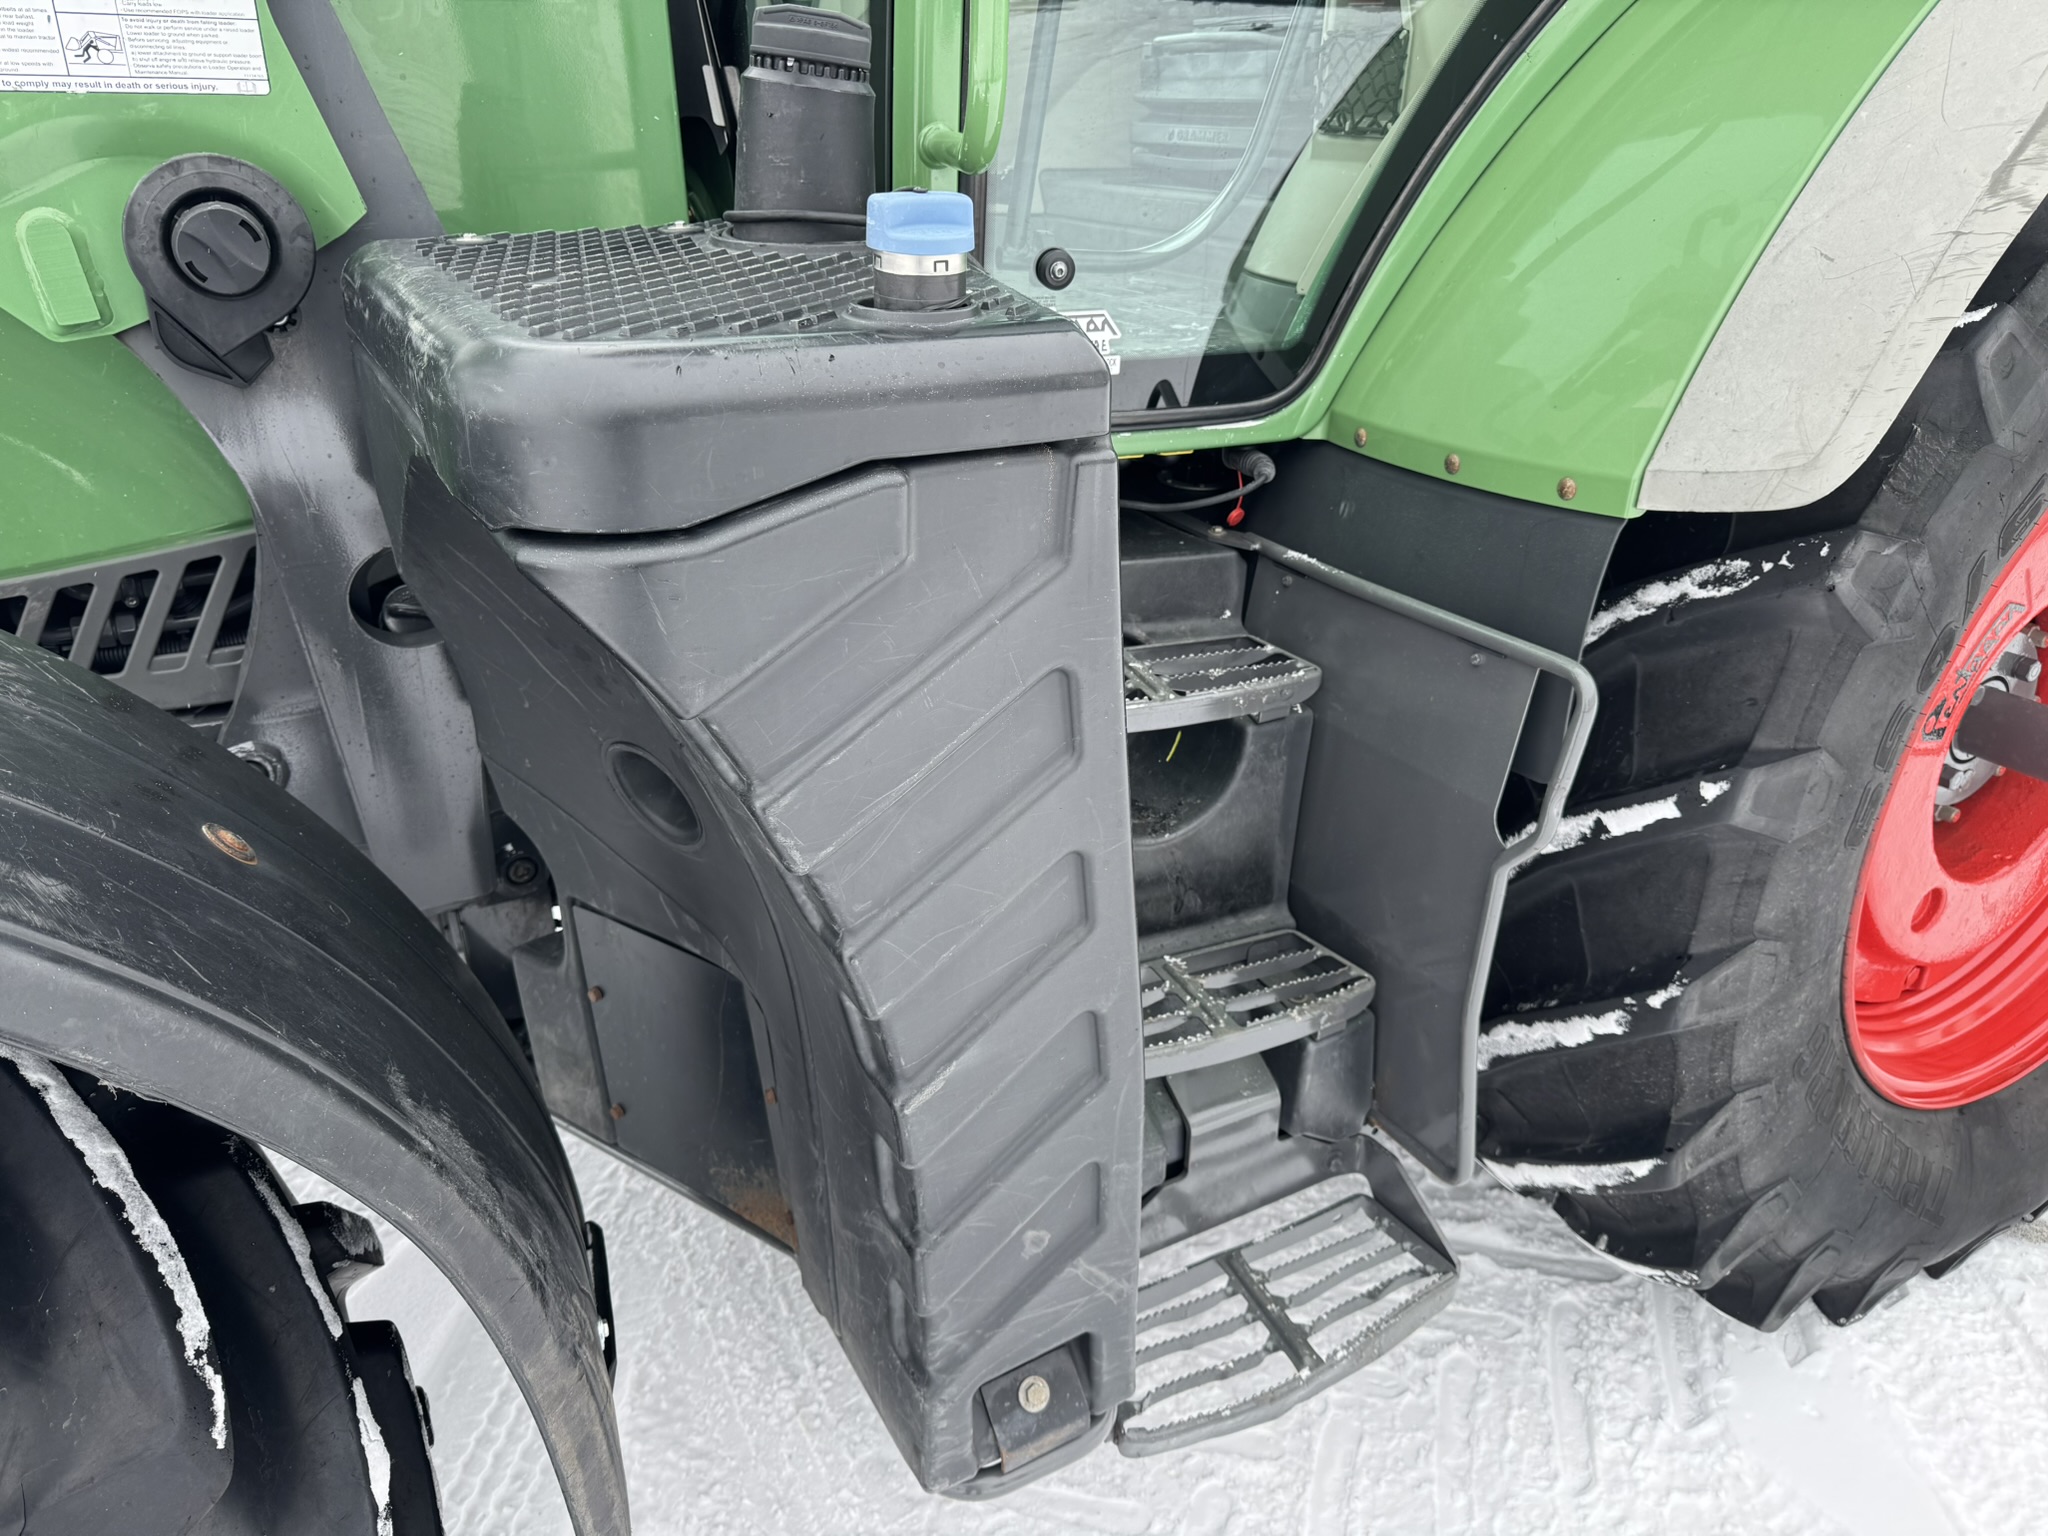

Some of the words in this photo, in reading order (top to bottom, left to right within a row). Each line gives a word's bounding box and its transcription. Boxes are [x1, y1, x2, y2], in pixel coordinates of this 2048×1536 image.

[14, 80, 49, 89] comply
[117, 81, 141, 89] death
[155, 82, 188, 90] serious
[191, 82, 218, 92] injury.
[1792, 1022, 1953, 1230] TRELLEBORG
